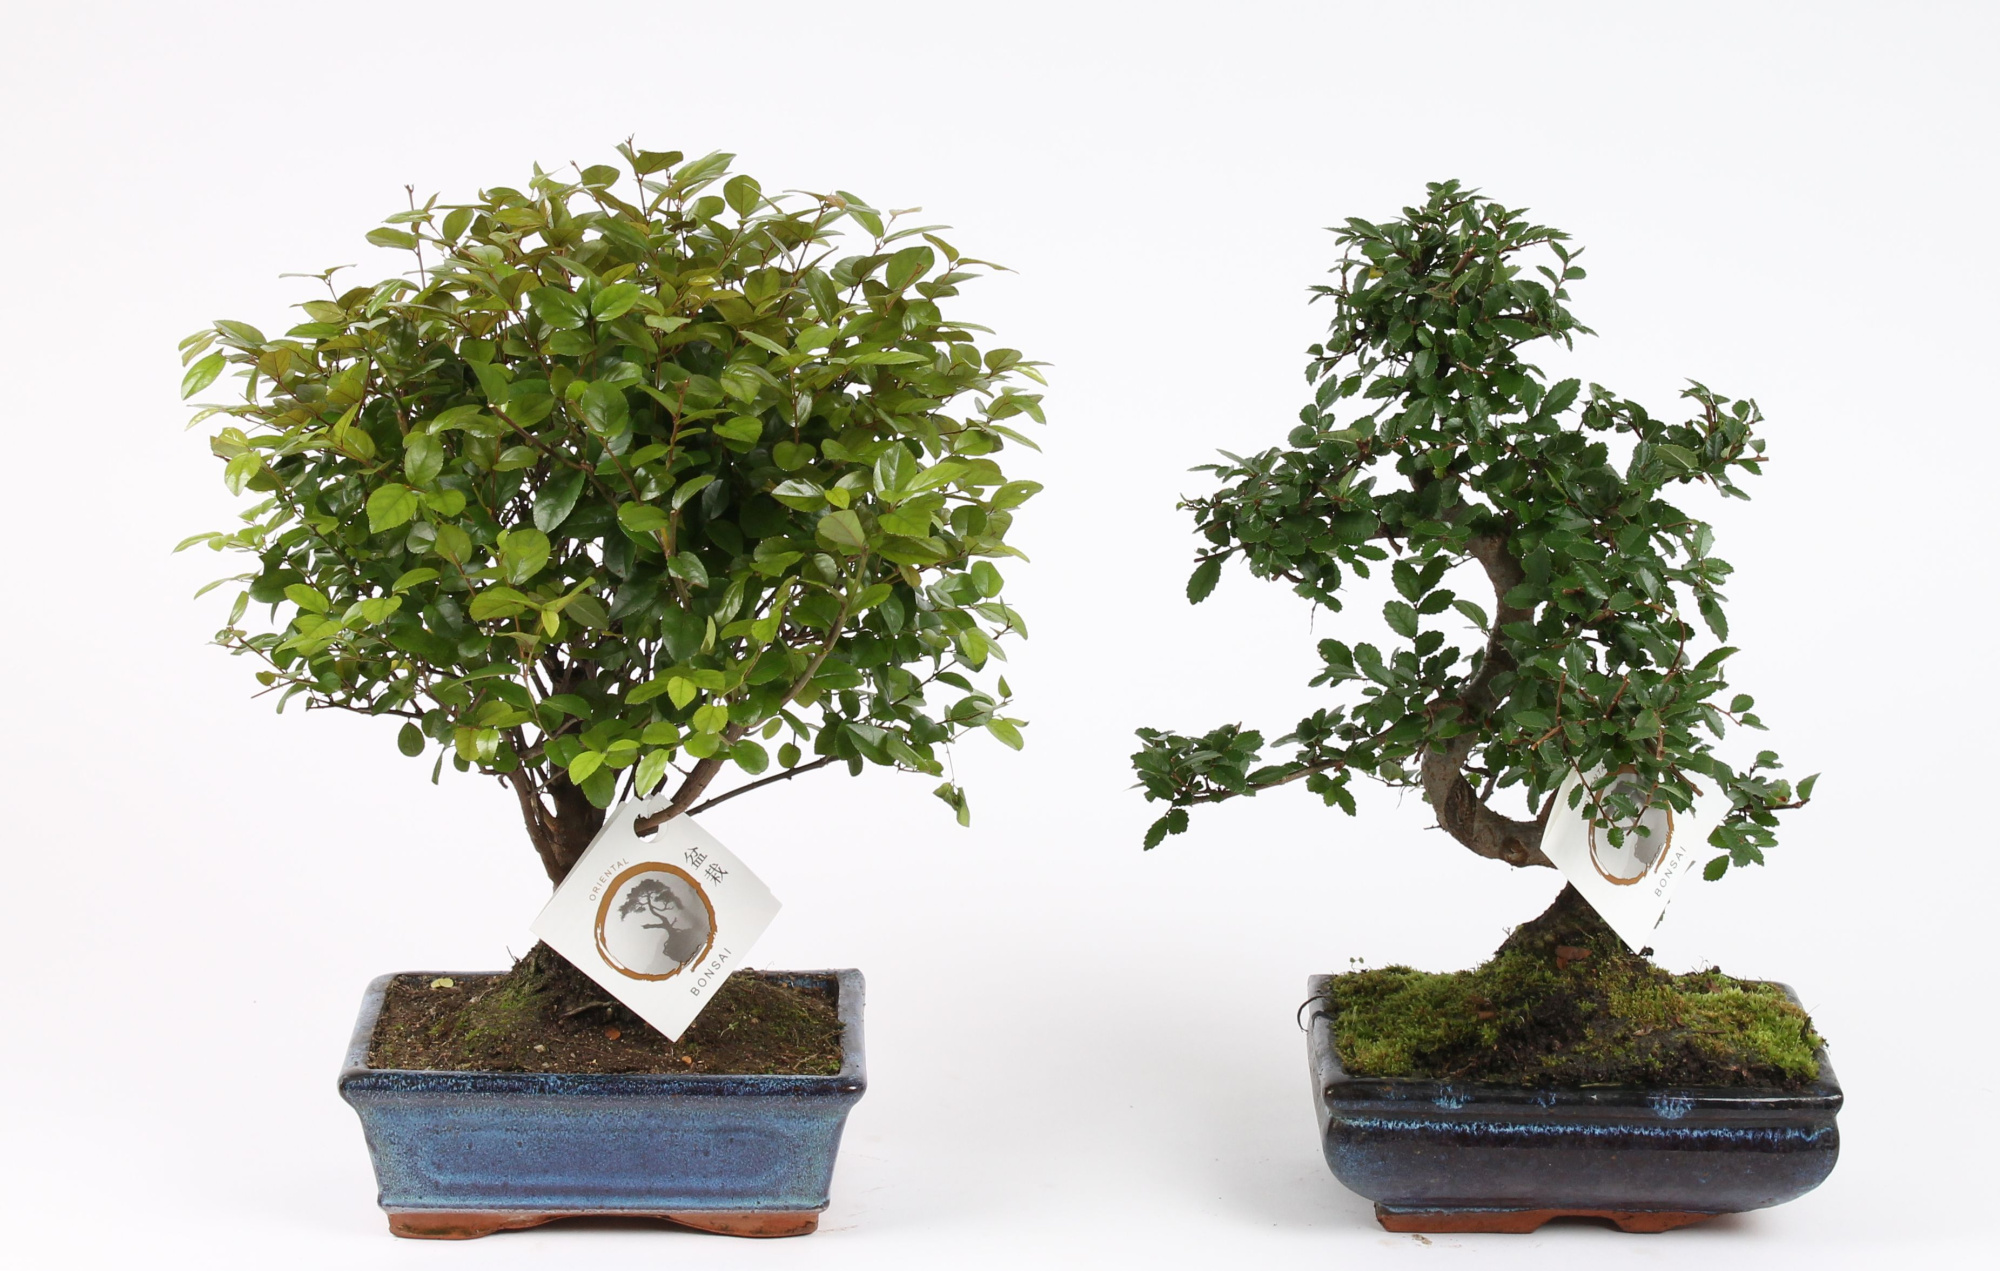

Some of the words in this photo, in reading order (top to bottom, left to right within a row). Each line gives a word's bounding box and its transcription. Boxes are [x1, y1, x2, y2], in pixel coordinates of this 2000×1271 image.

[589, 857, 630, 902] ORIENTAL
[684, 846, 729, 887] 盆栽
[1654, 845, 1687, 897] BONSAI
[690, 947, 732, 997] BONSAI
